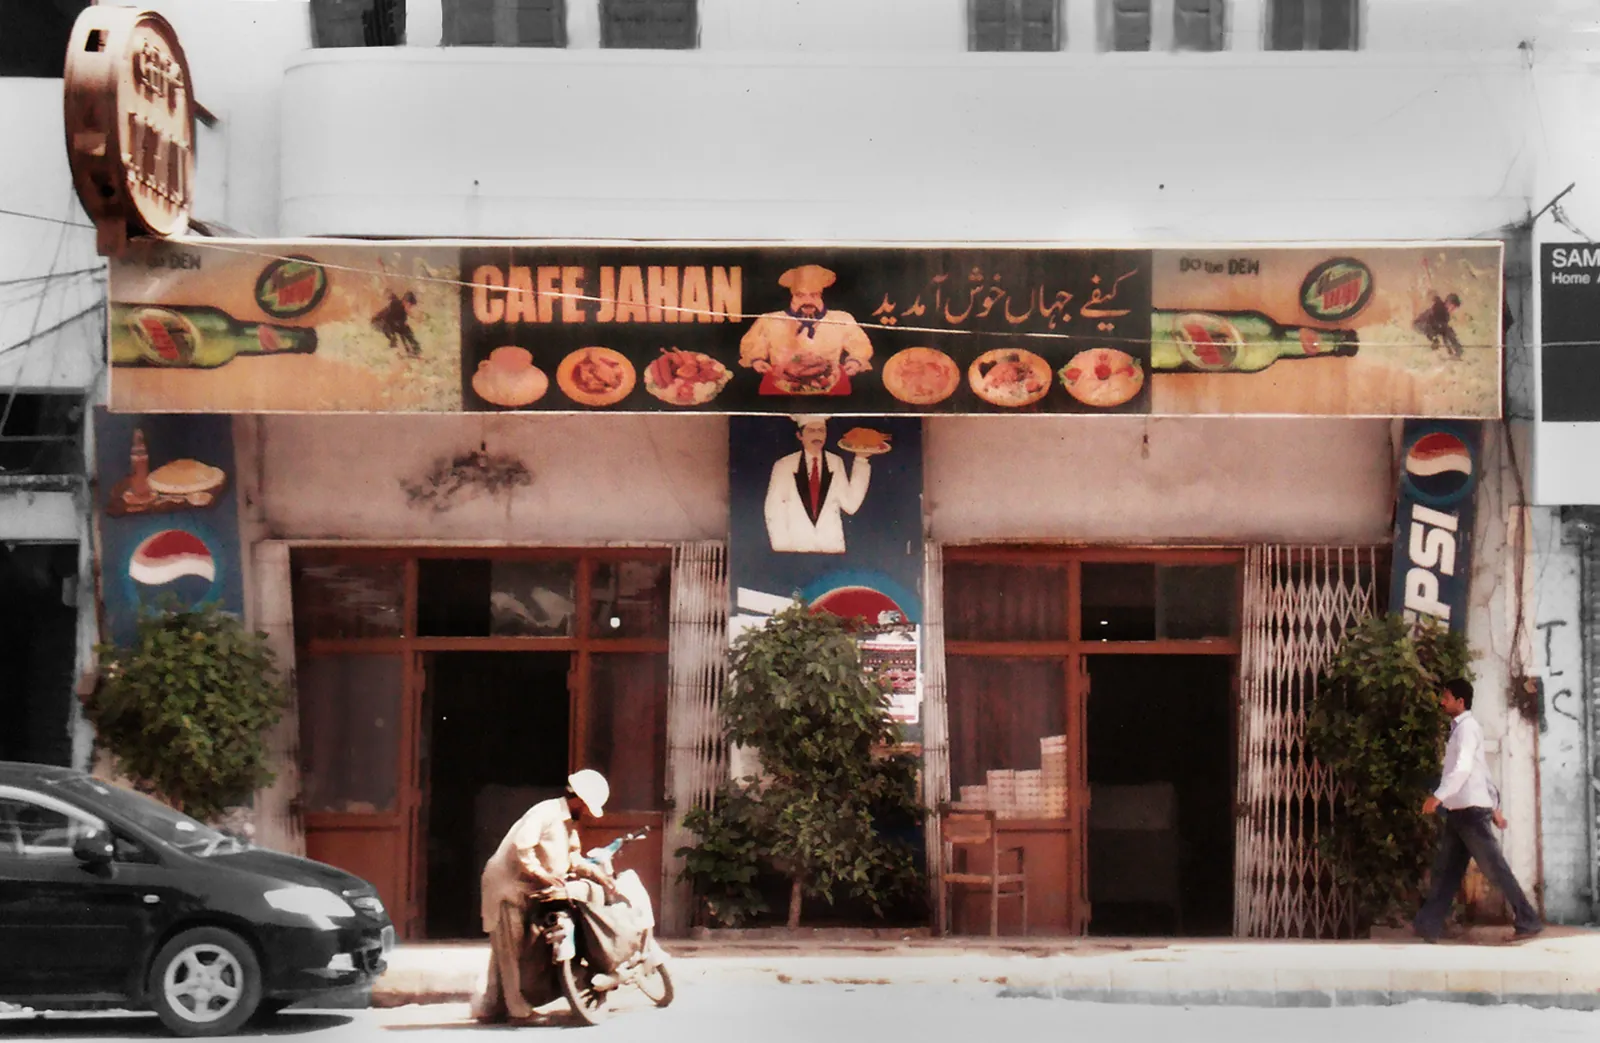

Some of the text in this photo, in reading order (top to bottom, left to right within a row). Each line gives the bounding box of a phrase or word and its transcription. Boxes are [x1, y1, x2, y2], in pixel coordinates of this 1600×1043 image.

[1228, 258, 1260, 275] DEW
[1552, 248, 1600, 267] SAM
[472, 265, 742, 324] CAFE JAHAN
[944, 266, 1006, 325] خوش
[1552, 271, 1591, 285] Home
[871, 273, 949, 326] آمدید
